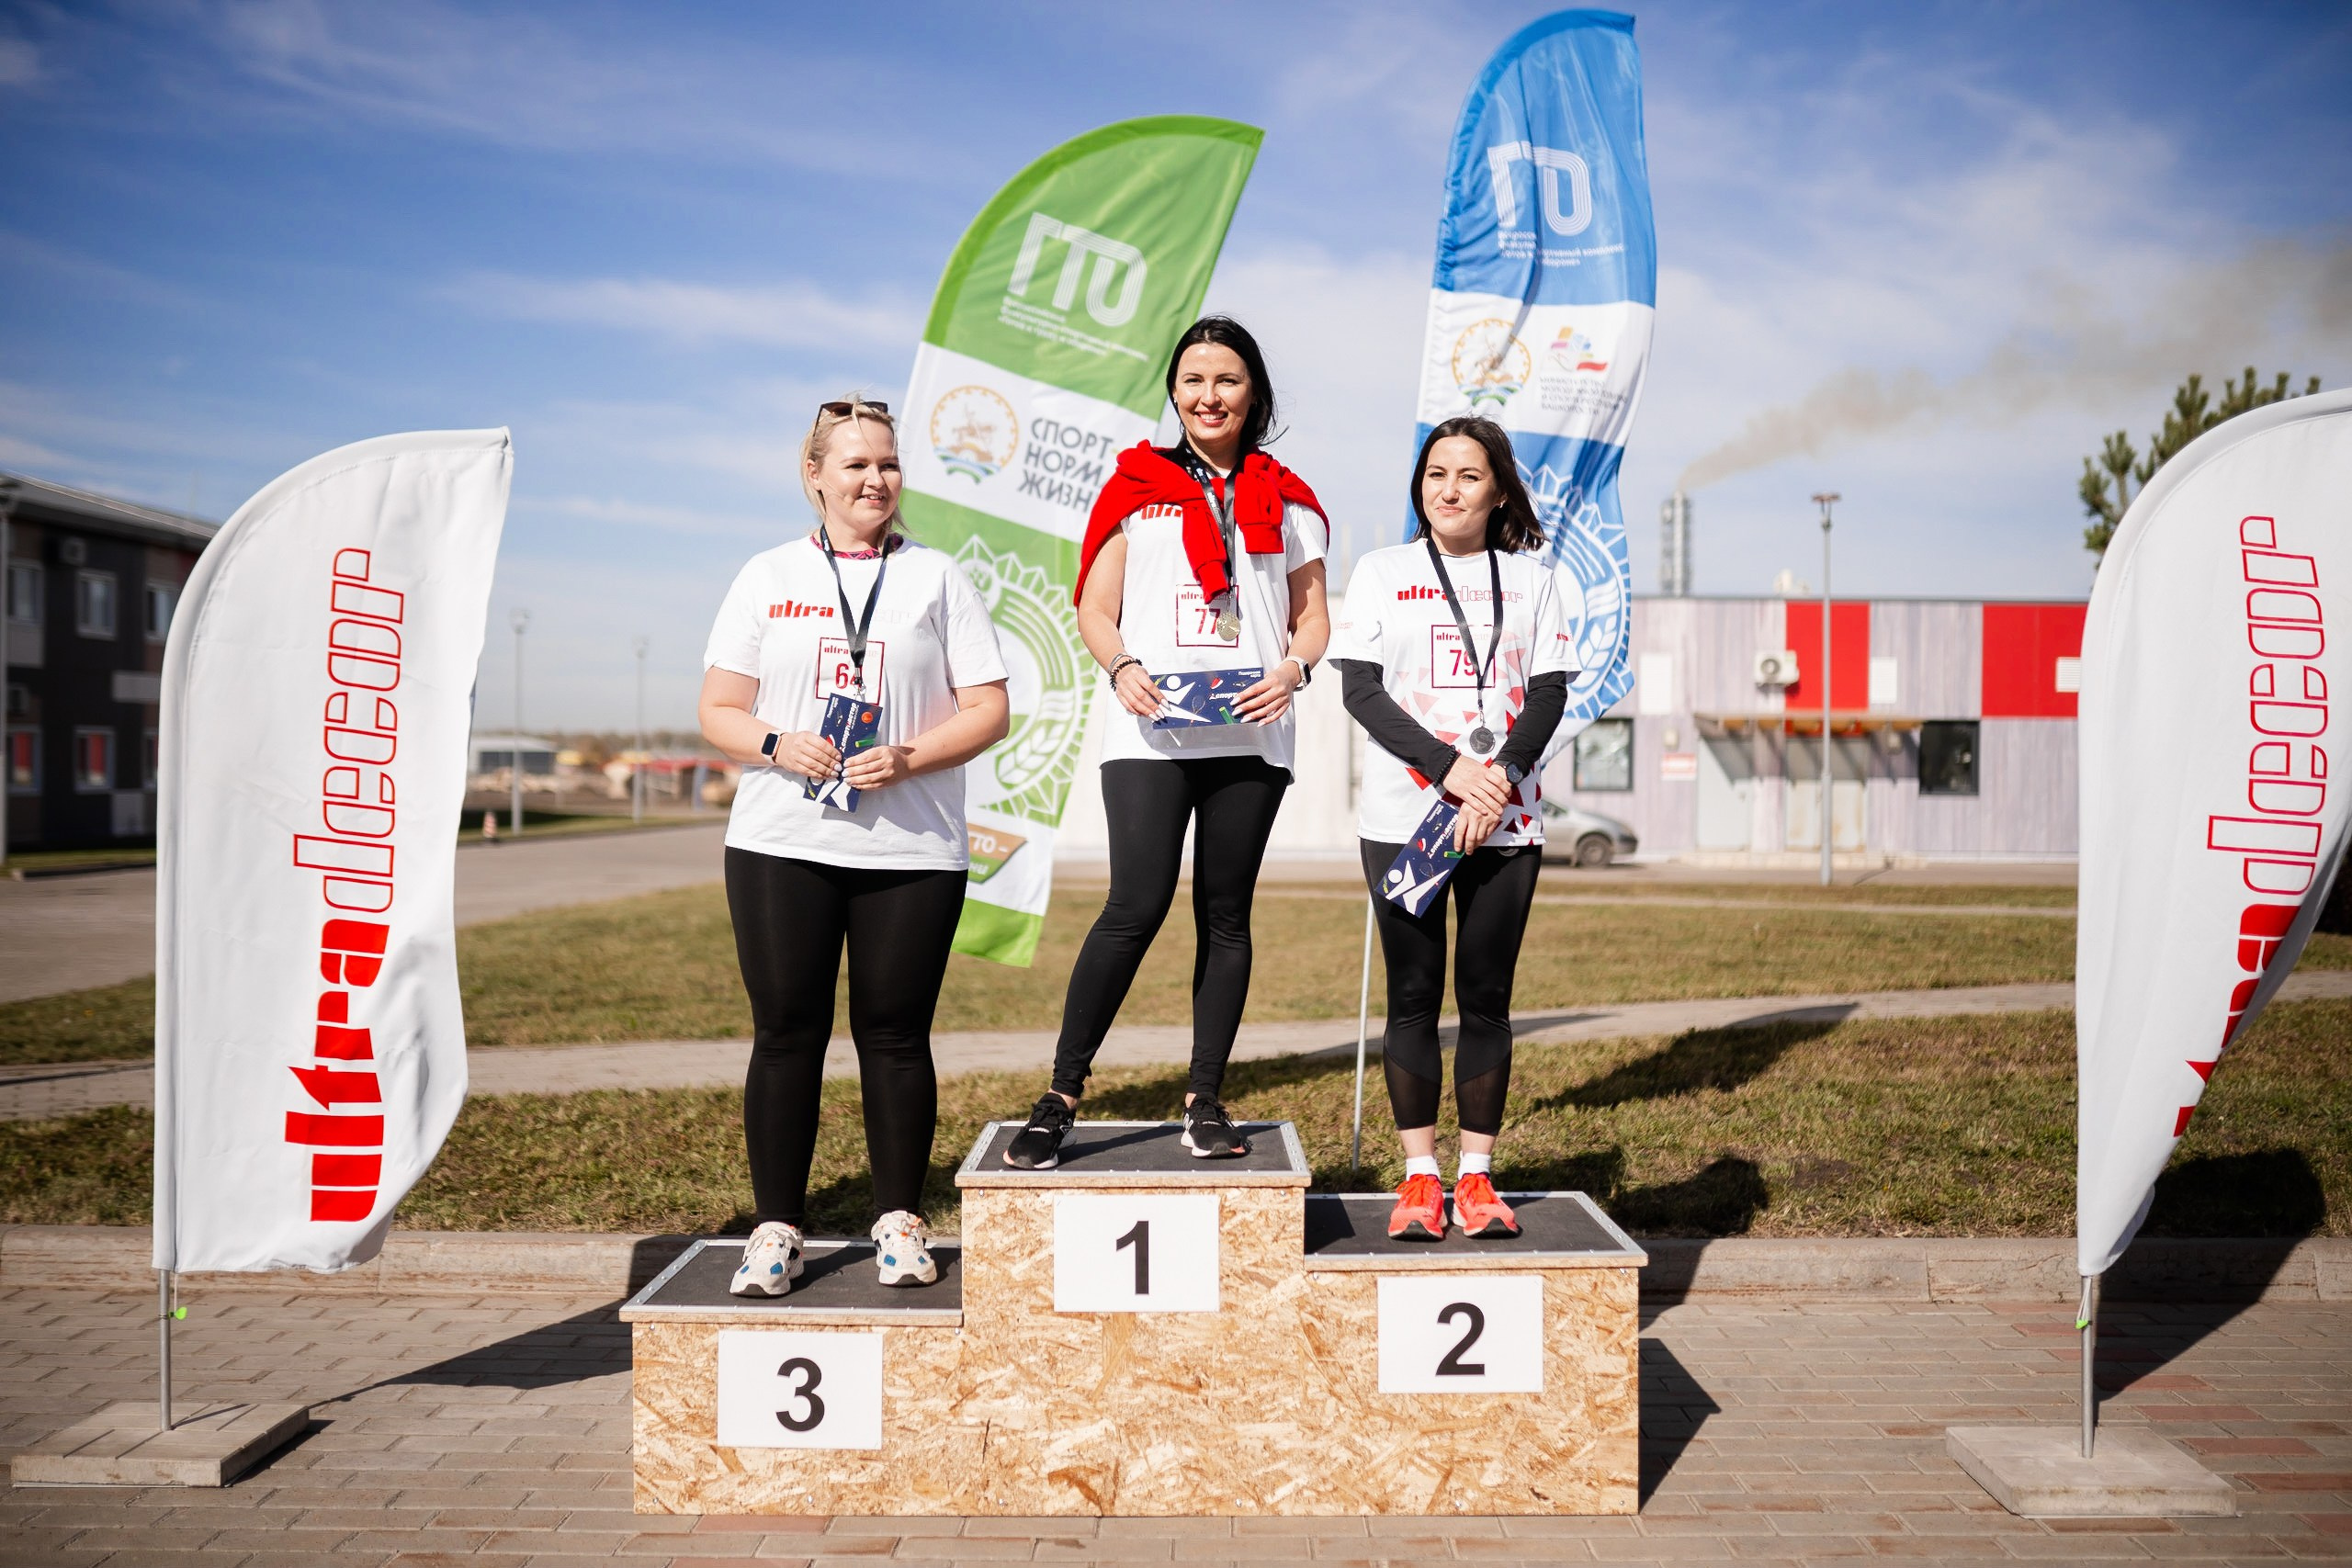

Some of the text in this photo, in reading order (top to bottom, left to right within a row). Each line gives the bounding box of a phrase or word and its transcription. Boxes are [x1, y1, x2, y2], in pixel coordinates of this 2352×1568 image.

[1007, 211, 1148, 328] ГТО
[1031, 417, 1114, 459] СПОРТ
[1023, 442, 1103, 488] НОРМ
[1017, 469, 1096, 513] ЖИЗН
[1194, 608, 1221, 635] 77
[1449, 649, 1477, 677] 79
[1216, 692, 1238, 700] спорт
[285, 547, 404, 1223] ultradecor
[1115, 1220, 1151, 1295] 1
[1435, 1302, 1486, 1376] 2
[775, 1357, 826, 1431] 3
